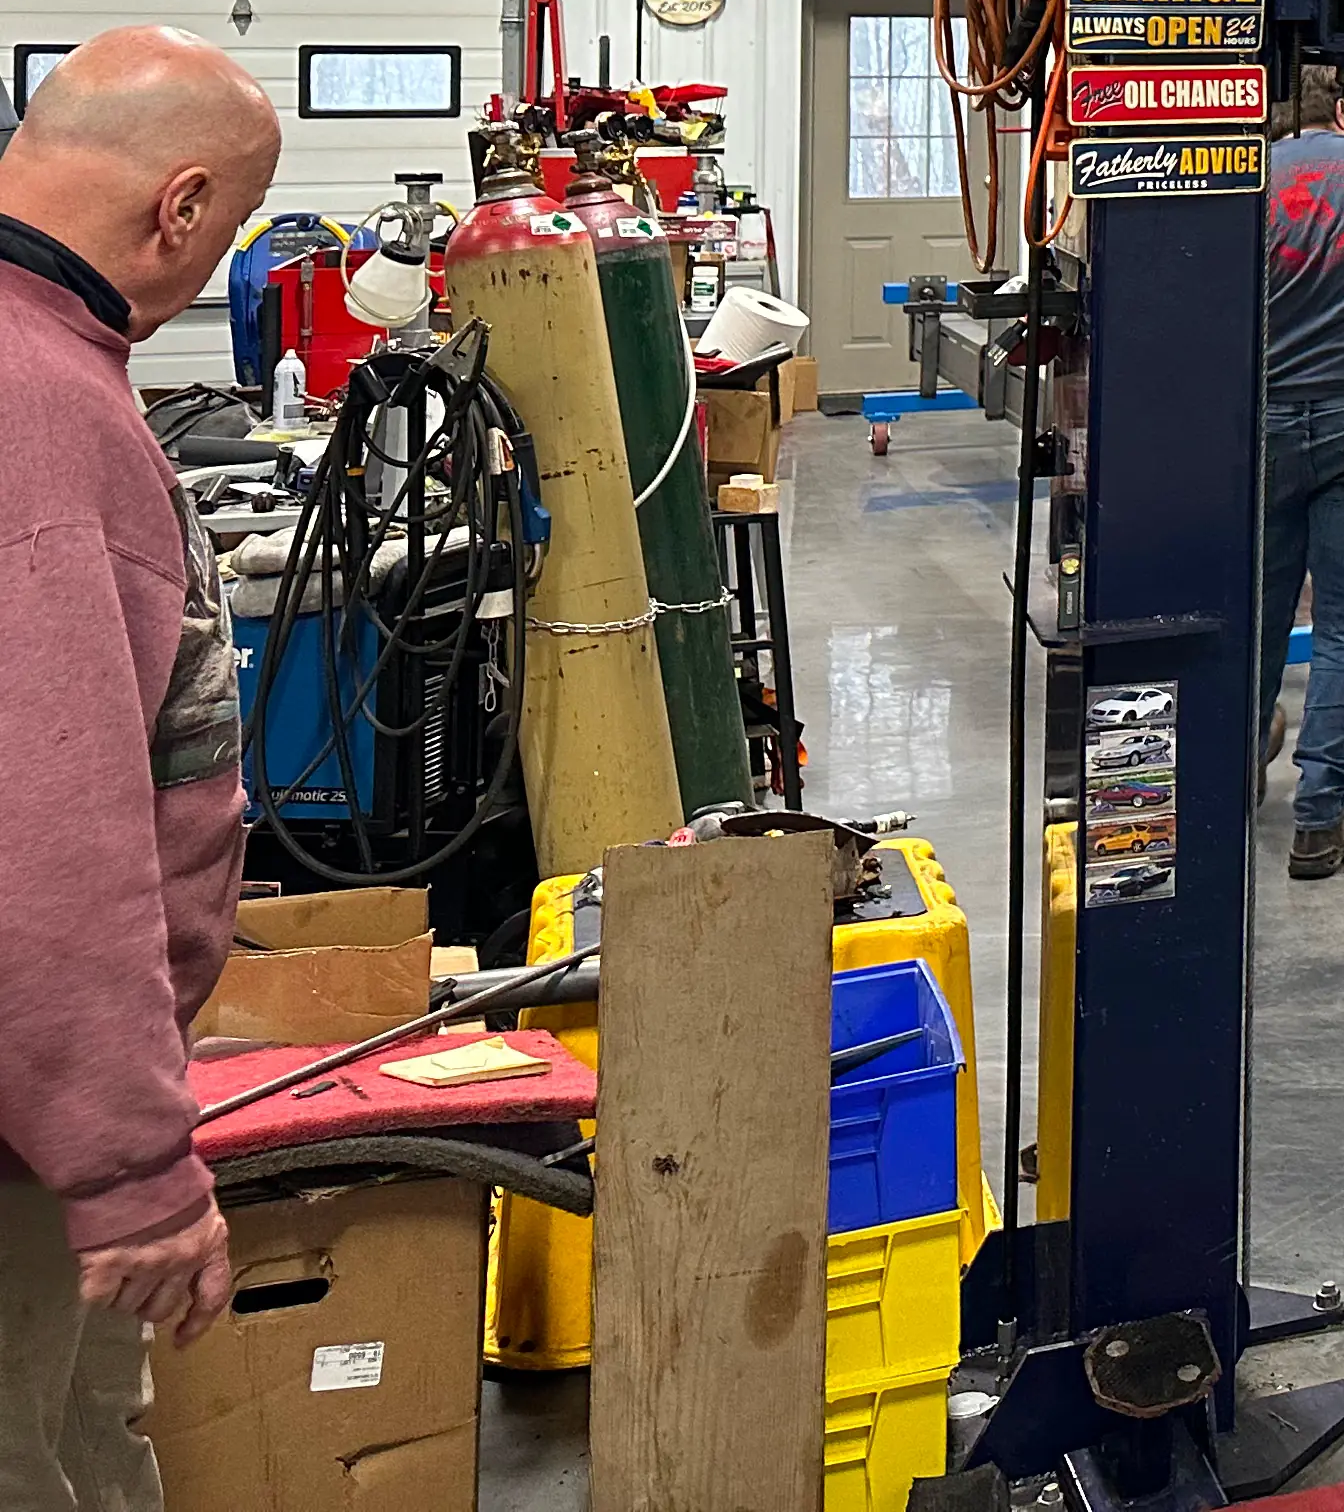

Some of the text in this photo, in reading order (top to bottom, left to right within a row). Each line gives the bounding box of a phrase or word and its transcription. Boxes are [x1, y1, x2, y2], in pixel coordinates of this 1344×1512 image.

[1072, 15, 1256, 46] ALWAYS OPEN 24
[1224, 37, 1257, 46] HOURS
[1073, 78, 1259, 118] Free OIL CHANGES
[1075, 144, 1178, 186] Fatherly
[1179, 146, 1259, 175] ADVICE
[1137, 179, 1208, 190] PRICELESS
